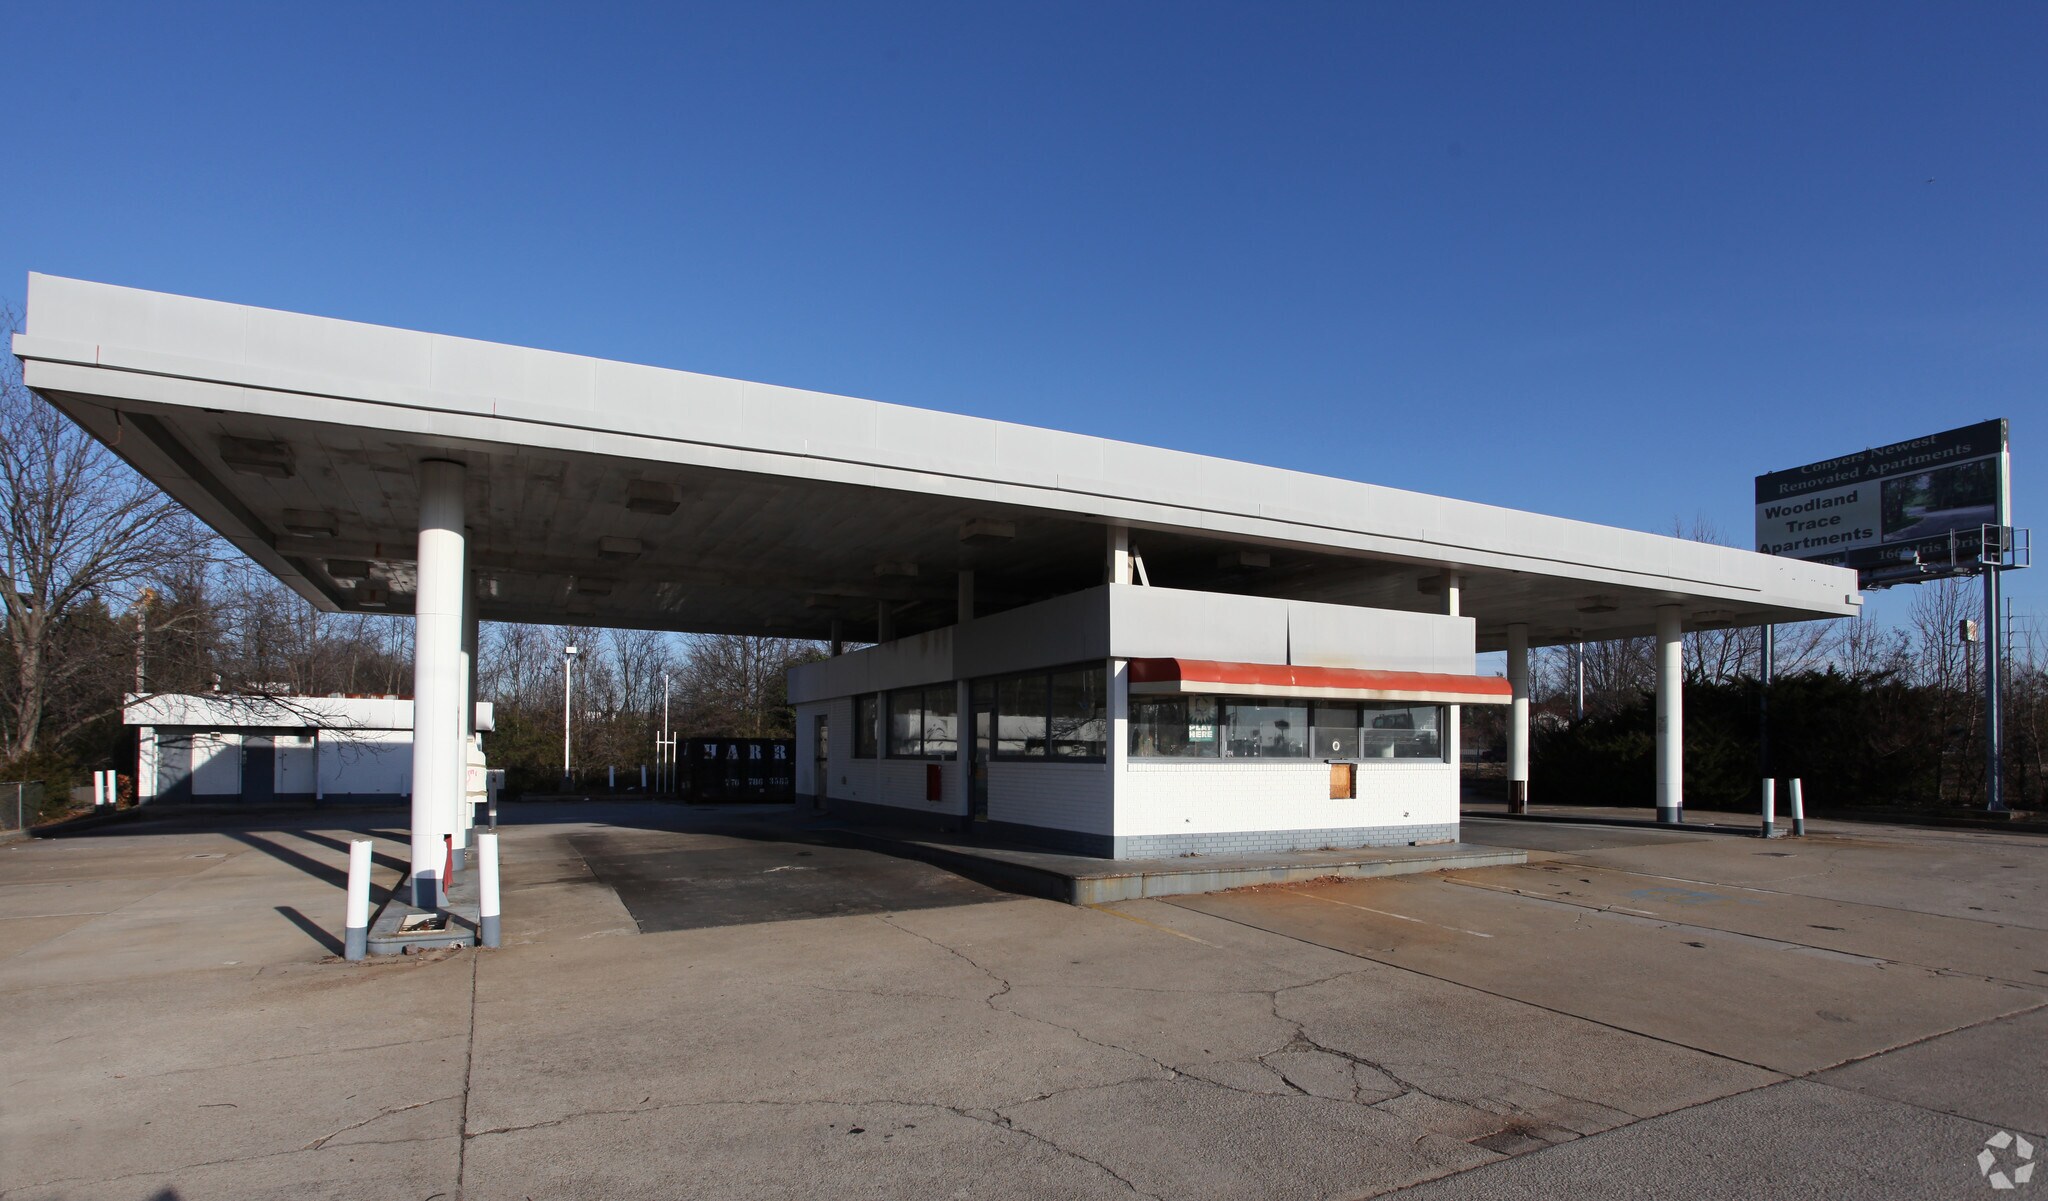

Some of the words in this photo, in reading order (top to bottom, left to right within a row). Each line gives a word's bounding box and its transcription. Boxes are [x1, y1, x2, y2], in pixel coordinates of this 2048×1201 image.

[1779, 467, 1859, 494] Renovated
[1864, 442, 1972, 476] Apartments
[1800, 453, 1865, 475] Conyers
[1870, 435, 1937, 459] Newest
[1765, 490, 1858, 520] Woodland
[1786, 514, 1841, 533] Trace
[1759, 527, 1873, 555] Apartments
